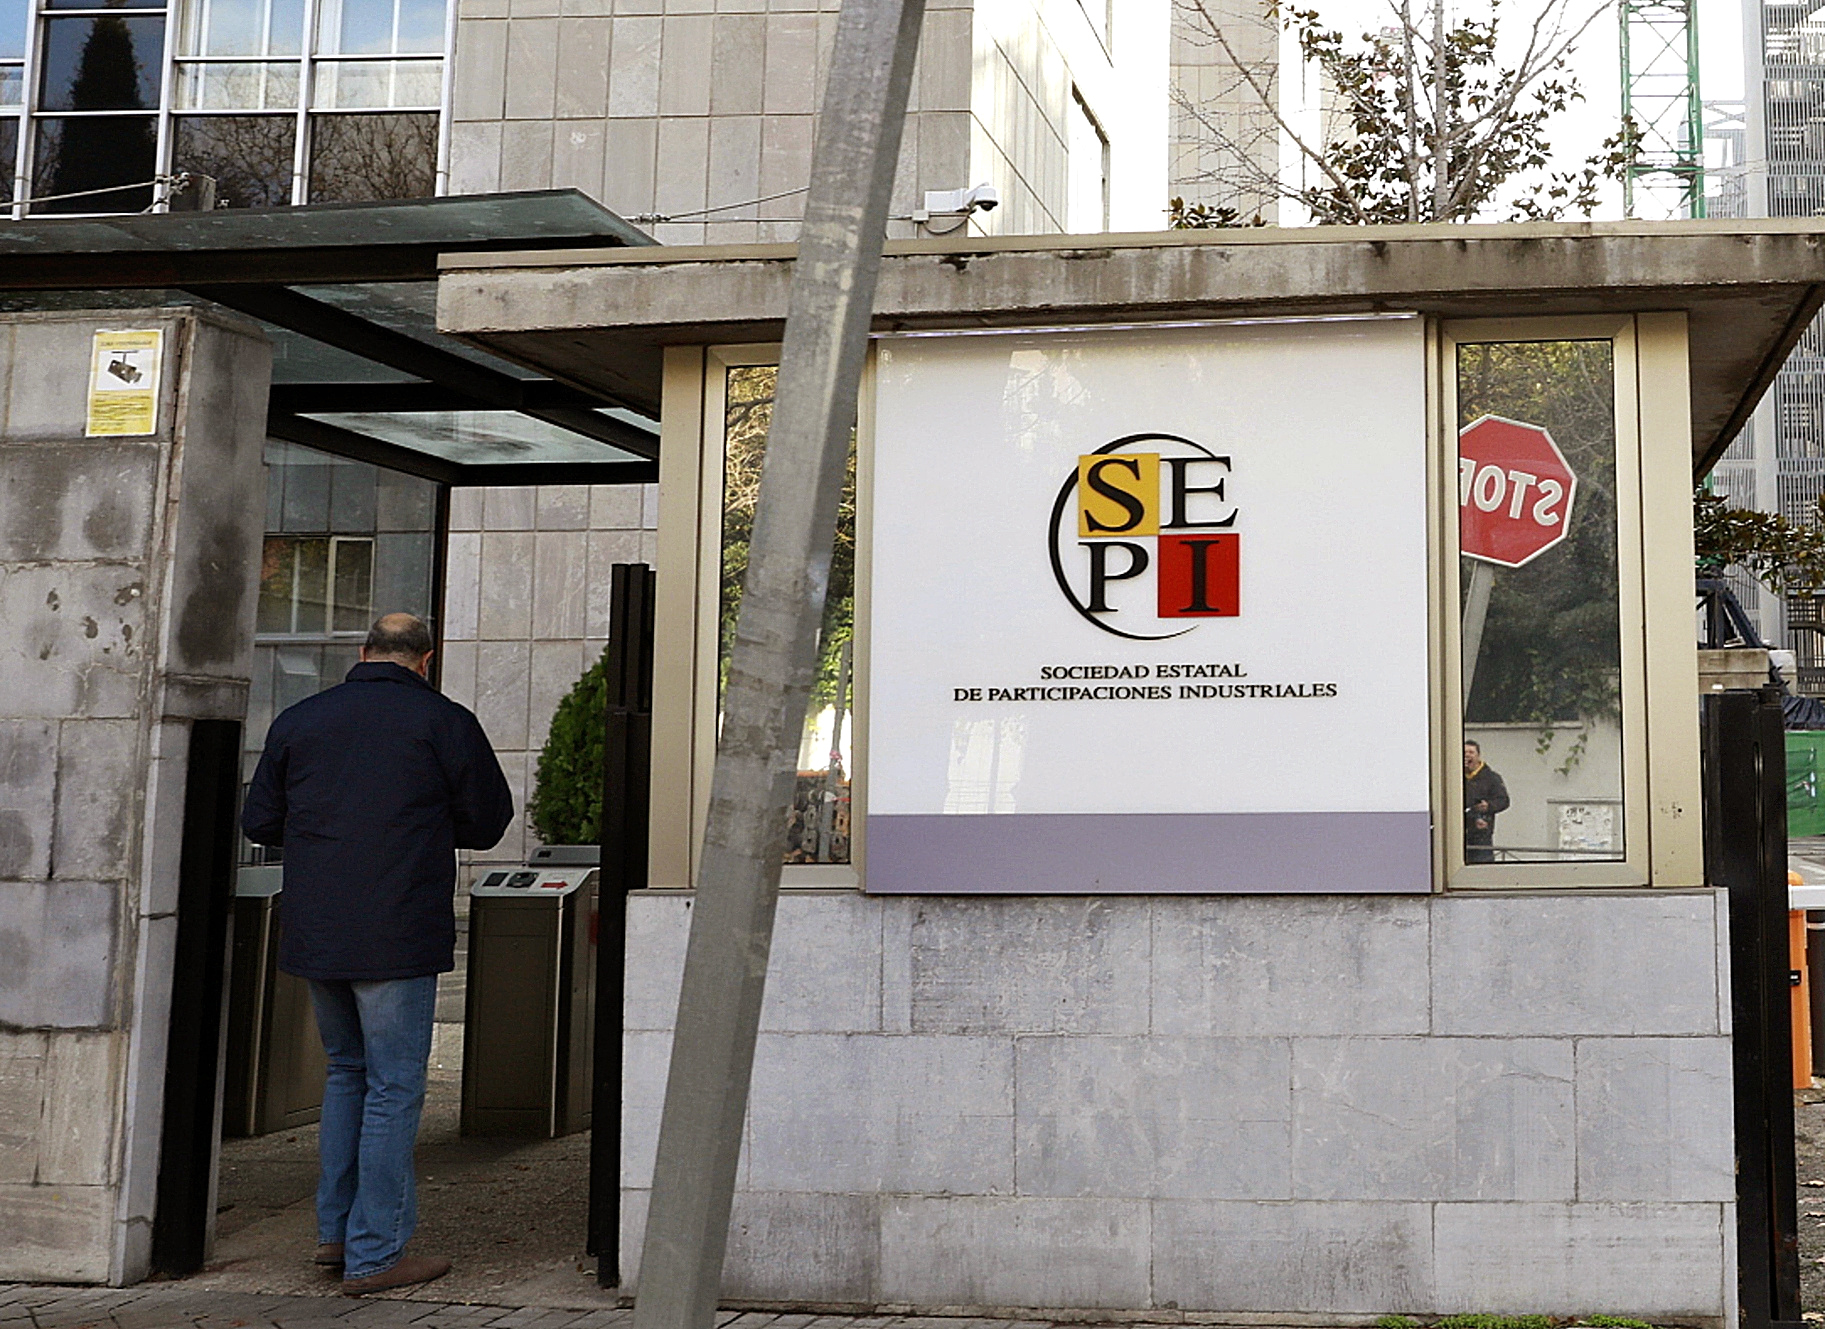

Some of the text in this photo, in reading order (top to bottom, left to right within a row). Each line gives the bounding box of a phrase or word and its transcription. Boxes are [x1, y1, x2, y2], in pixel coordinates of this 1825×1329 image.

[1040, 663, 1248, 680] SOCIEDAD ESTATAL
[953, 683, 1338, 702] DE PARTICIPACIONES INDUSTRIALES
